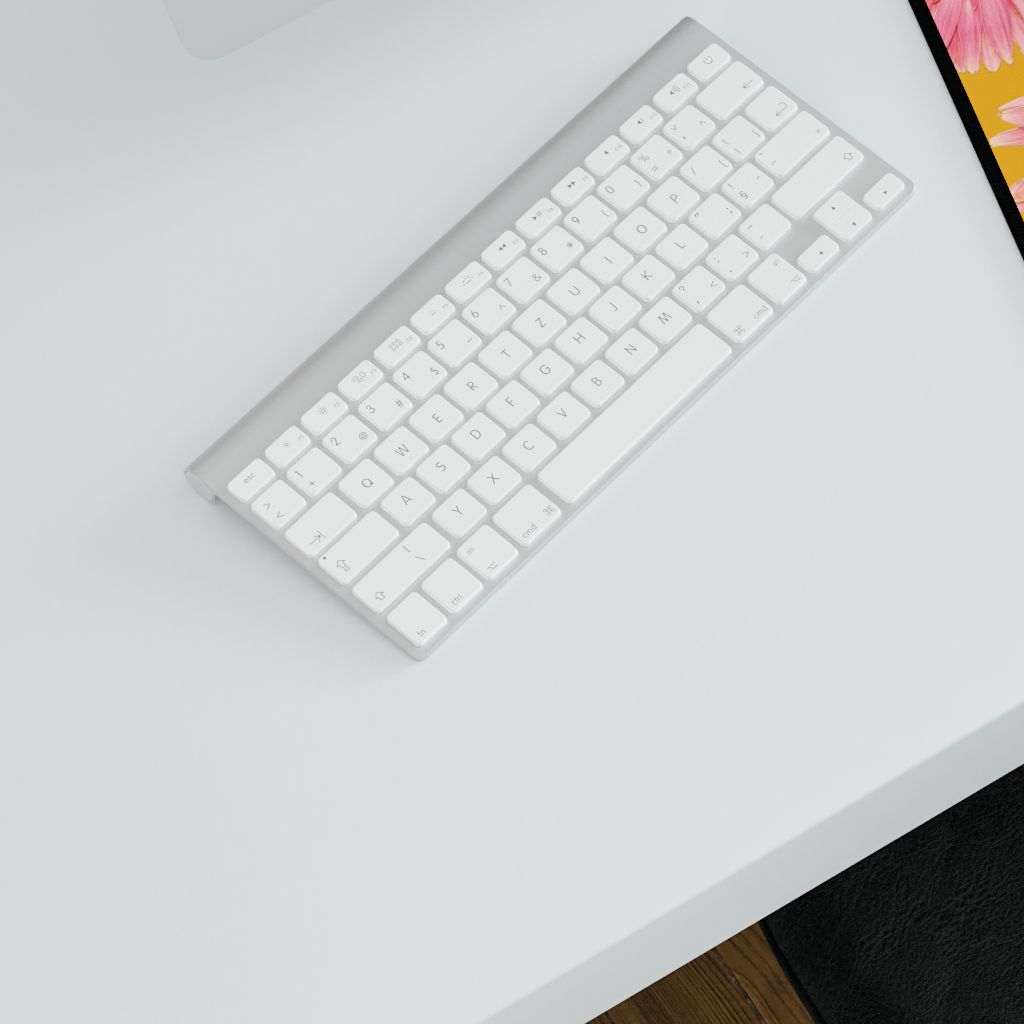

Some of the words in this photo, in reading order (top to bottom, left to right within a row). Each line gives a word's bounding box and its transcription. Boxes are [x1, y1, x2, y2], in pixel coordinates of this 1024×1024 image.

[604, 185, 615, 195] 0
[668, 193, 679, 204] P
[570, 215, 581, 225] 9
[635, 224, 648, 235] O
[674, 241, 687, 250] L
[537, 247, 548, 256] 8
[639, 269, 654, 281] K
[502, 277, 513, 287] 7
[567, 284, 581, 297] U
[608, 301, 619, 312] J
[753, 304, 769, 320] cmd
[470, 309, 480, 319] 6
[657, 311, 673, 326] M
[534, 316, 548, 329] Z
[571, 331, 587, 345] H
[434, 340, 446, 351] 5
[623, 343, 639, 356] N
[499, 348, 512, 359] T
[538, 363, 552, 375] G
[401, 371, 412, 381] 4
[465, 380, 479, 392] R
[590, 376, 603, 388] B
[504, 396, 515, 408] F
[364, 404, 376, 415] 3
[555, 407, 568, 418] V
[431, 412, 444, 424] E
[468, 428, 483, 441] D
[329, 436, 342, 447] 2
[522, 440, 535, 451] C
[393, 443, 410, 457] W
[435, 461, 448, 472] S
[360, 477, 375, 489] Q
[486, 472, 501, 486] X
[400, 495, 414, 507] A
[450, 505, 464, 516] Y
[521, 523, 538, 539] cmd
